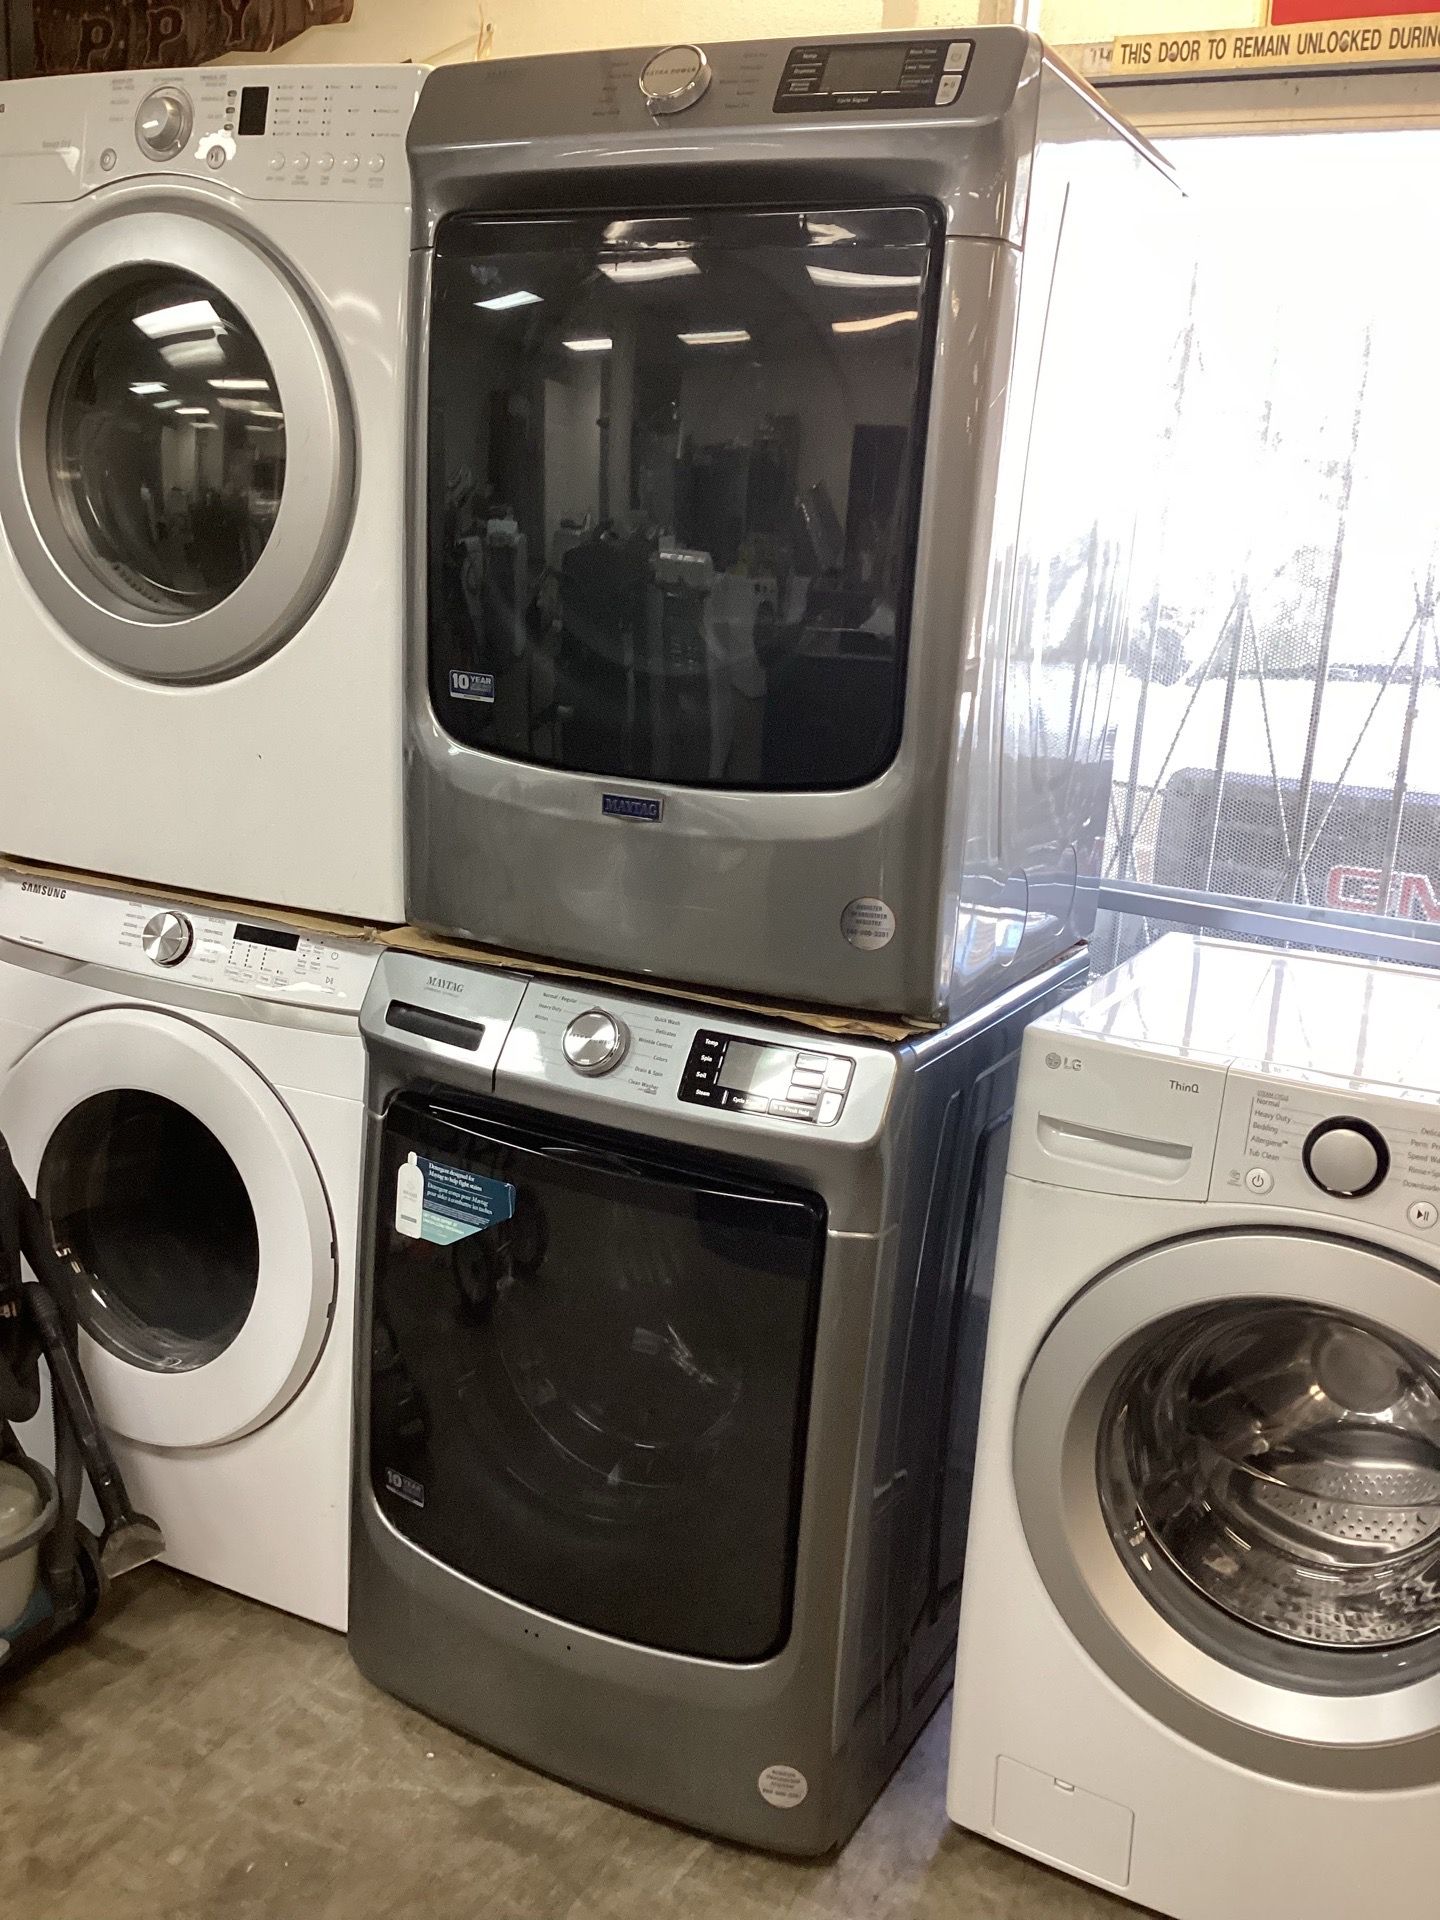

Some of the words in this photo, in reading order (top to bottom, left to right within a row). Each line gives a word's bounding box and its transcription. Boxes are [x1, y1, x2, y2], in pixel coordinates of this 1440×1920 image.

[1121, 42, 1152, 64] THIS
[1158, 39, 1201, 63] DOOR
[1208, 38, 1227, 60] TO
[1233, 34, 1291, 58] REMAIN
[1297, 29, 1382, 55] UNLOCKED
[1389, 25, 1440, 49] DURIN
[452, 673, 469, 689] 10
[470, 675, 492, 685] YEAR
[604, 798, 657, 816] MAYTAG
[21, 881, 67, 900] SAMSUNG
[426, 976, 465, 993] MAYTAG
[654, 1015, 667, 1023] Quick
[705, 1038, 719, 1047] Temp
[700, 1054, 713, 1062] Spin
[1169, 1079, 1200, 1094] ThinQ
[1256, 1098, 1280, 1108] Normal
[1254, 1110, 1274, 1120] Heavy
[1275, 1113, 1291, 1124] Duty
[1252, 1121, 1279, 1134] Bedding
[1249, 1148, 1260, 1157] Tub
[1261, 1151, 1280, 1161] Clean
[387, 1470, 402, 1488] 10
